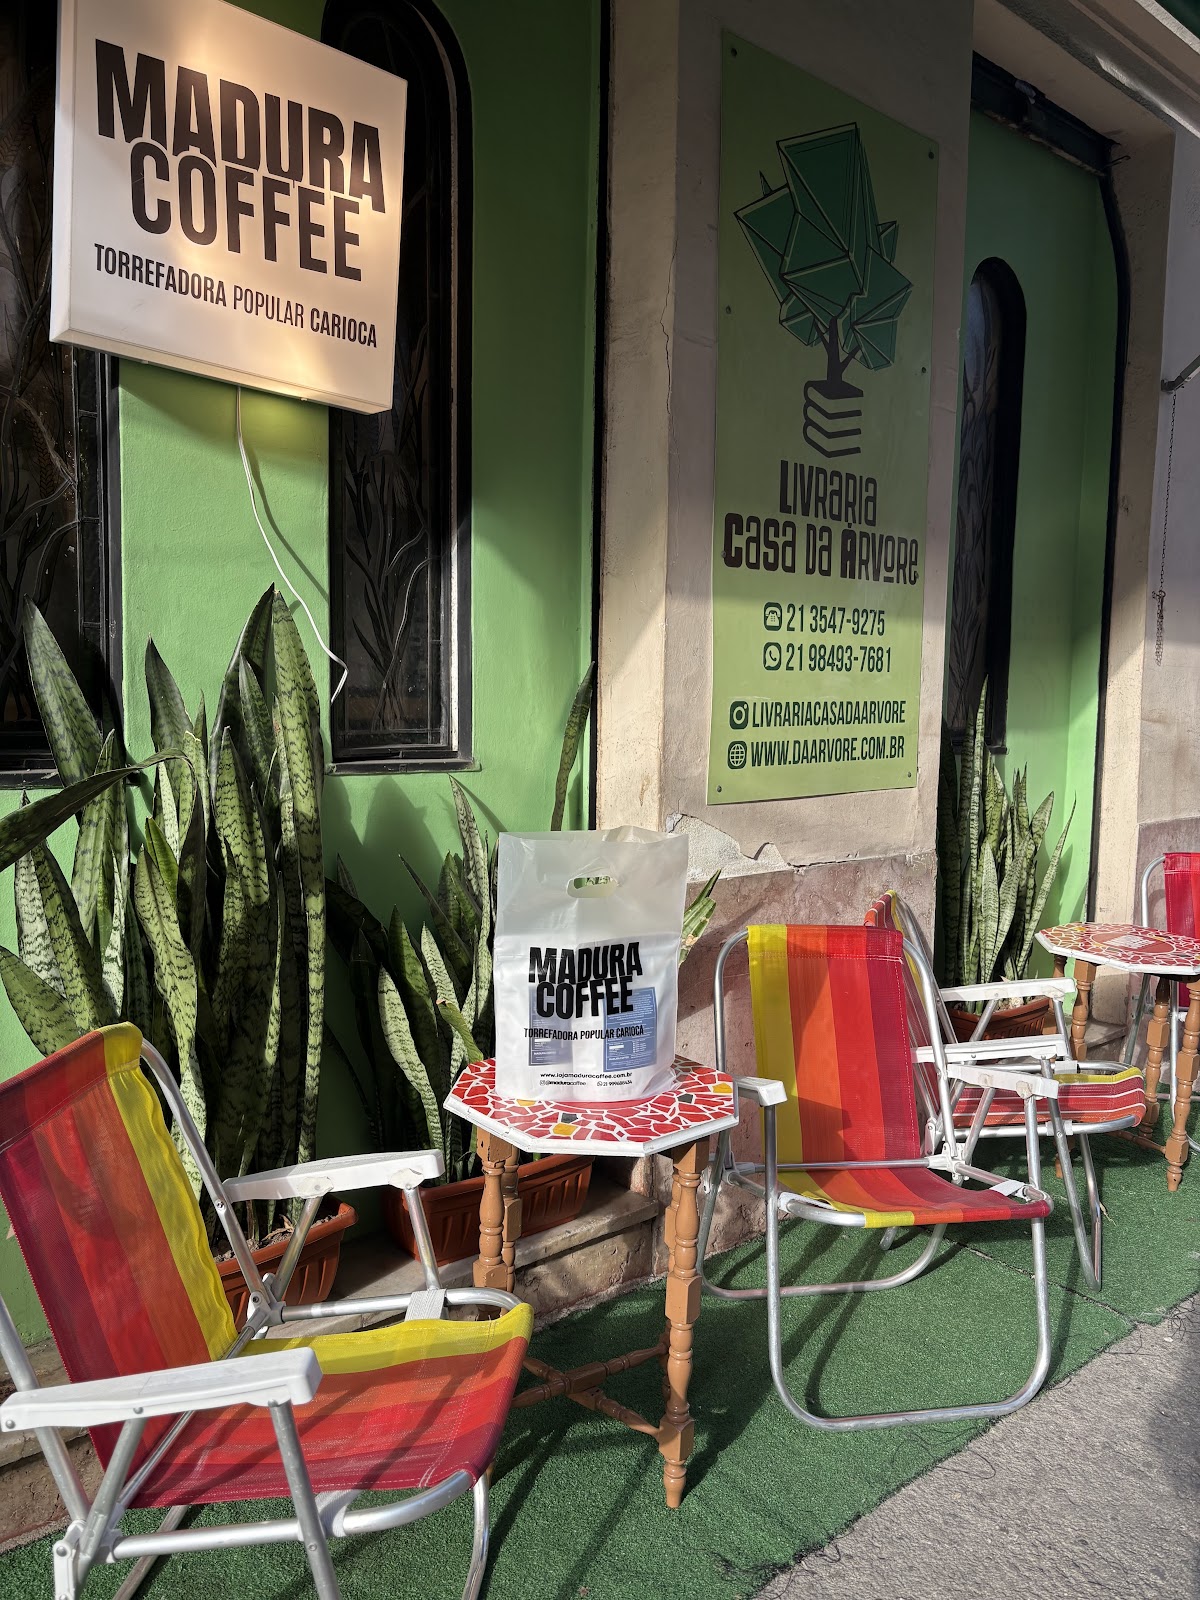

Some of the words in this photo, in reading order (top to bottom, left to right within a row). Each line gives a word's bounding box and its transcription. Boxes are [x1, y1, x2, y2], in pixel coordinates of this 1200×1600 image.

[95, 39, 386, 214] MADURA
[130, 142, 362, 281] COFFEE
[94, 243, 227, 307] TORREFADORA
[233, 285, 304, 328] POPULAR
[310, 307, 377, 348] CARIOCA
[786, 603, 804, 632] 21
[809, 605, 885, 636] 3547-9275
[785, 643, 803, 671] 21
[808, 643, 891, 673] 98493-7681
[752, 700, 906, 728] LIVRARIACASADAARVORE
[751, 735, 905, 767] WWW.DAARVORE.COM.BR
[529, 942, 643, 984] MADURA
[536, 975, 634, 1020] COFFEE
[524, 1027, 578, 1041] TORREFADORA
[580, 1027, 615, 1040] POPULAR
[616, 1024, 644, 1039] CARIOCA
